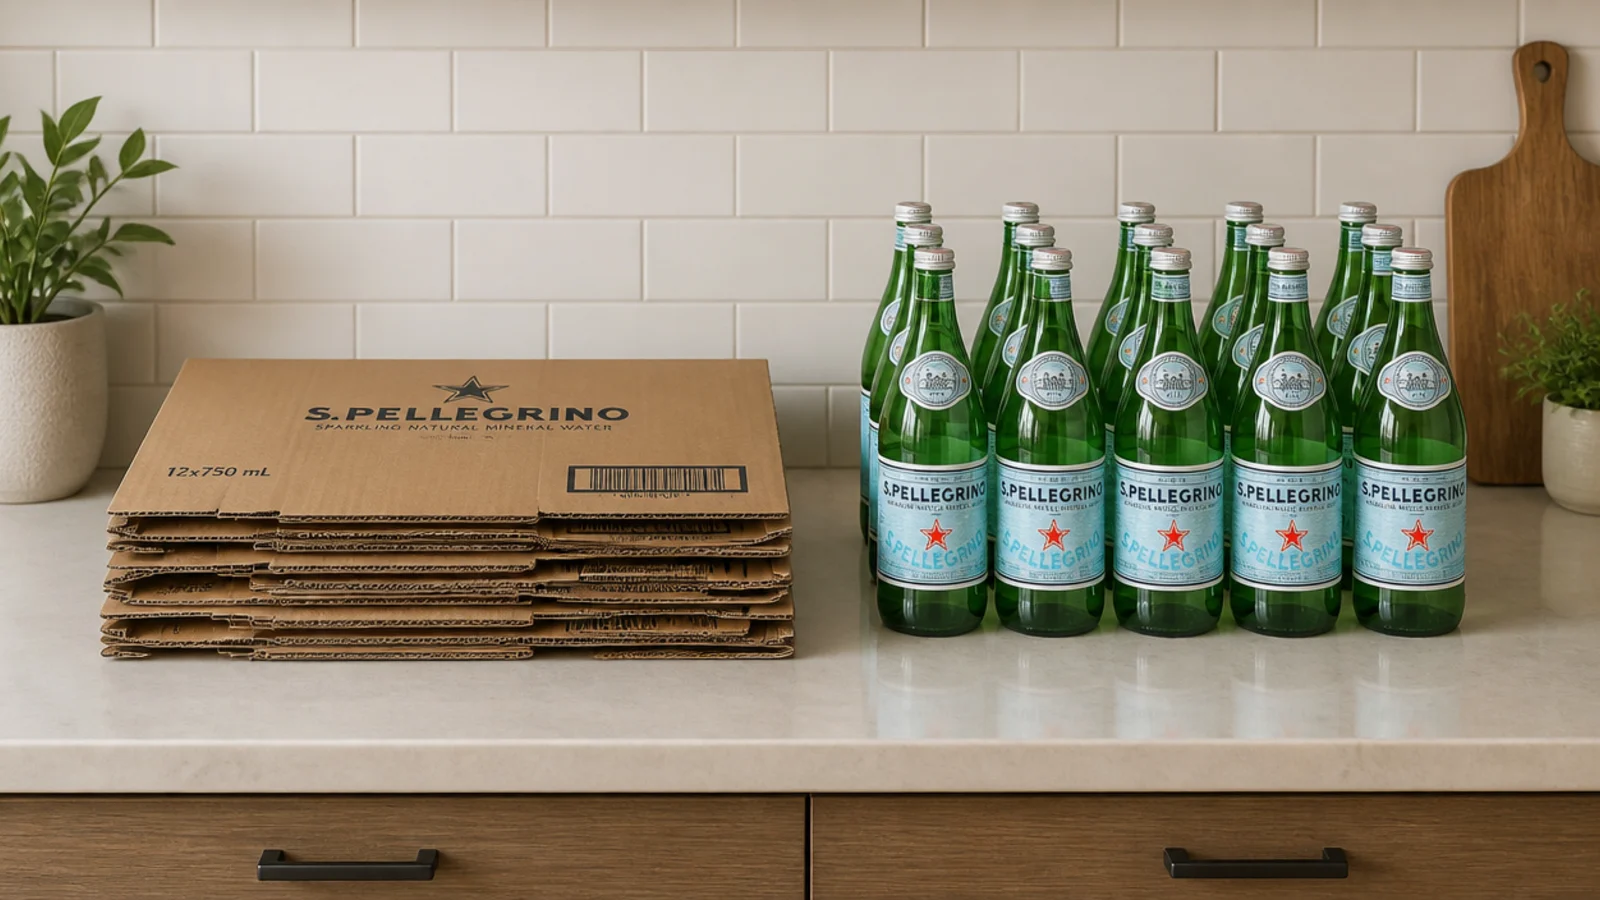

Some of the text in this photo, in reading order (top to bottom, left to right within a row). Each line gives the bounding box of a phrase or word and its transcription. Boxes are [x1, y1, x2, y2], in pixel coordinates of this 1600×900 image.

[305, 407, 629, 422] S.PELLEGRINO
[167, 466, 271, 477] 12x750 mL
[883, 480, 986, 503] S.PELLEGRINO
[1001, 480, 1103, 503] S.PELLEGRINO
[1120, 480, 1223, 504] S.PELLEGRINO
[1236, 481, 1341, 504] S.PELLEGRINO
[1361, 481, 1465, 503] S.PELLEGRINO
